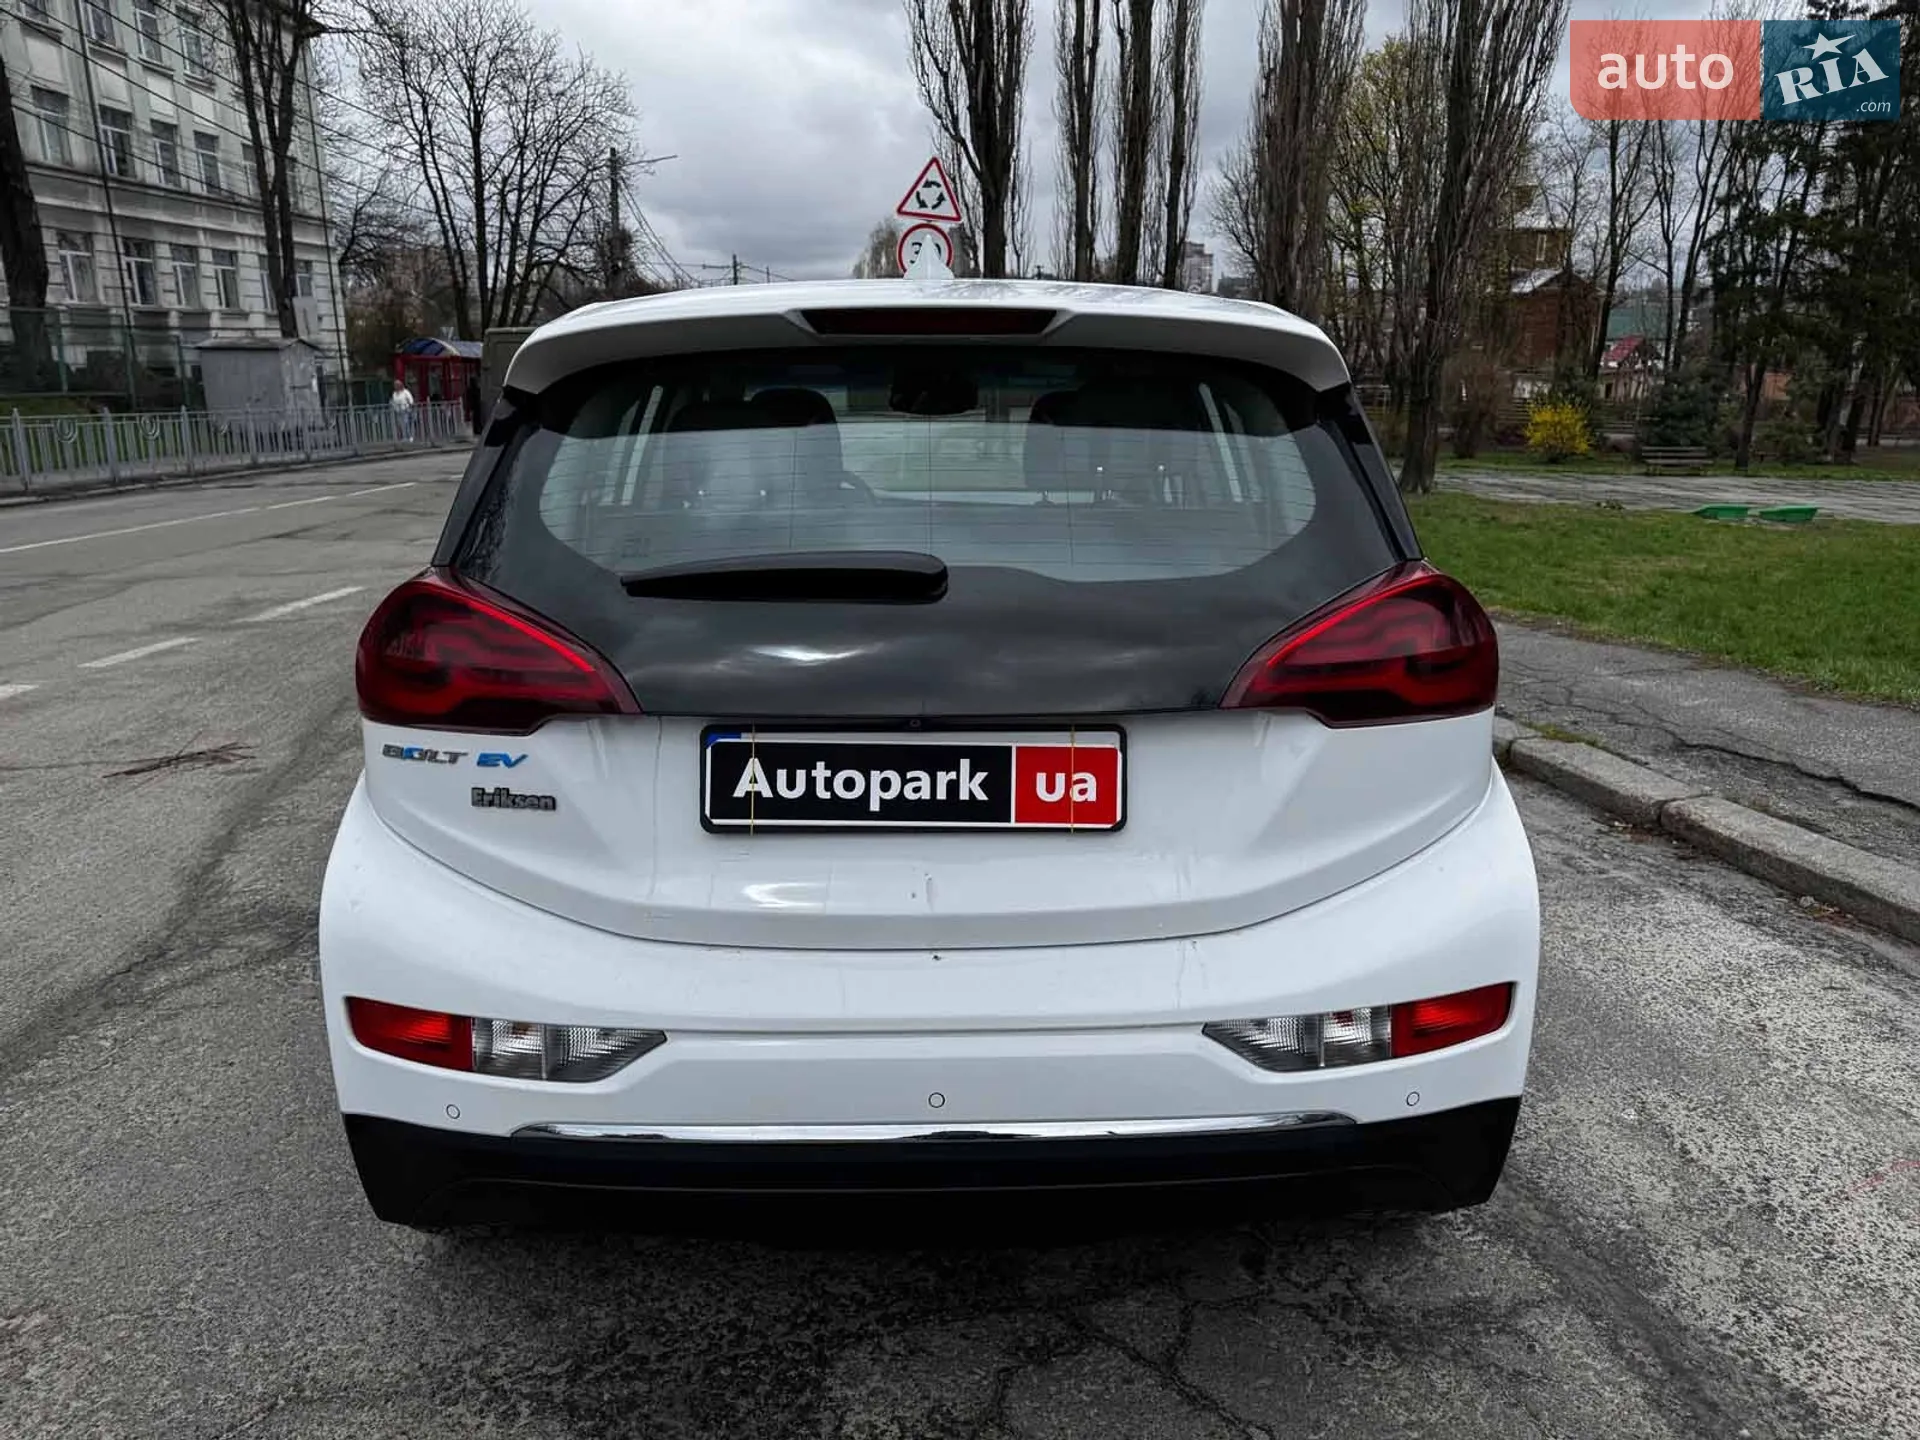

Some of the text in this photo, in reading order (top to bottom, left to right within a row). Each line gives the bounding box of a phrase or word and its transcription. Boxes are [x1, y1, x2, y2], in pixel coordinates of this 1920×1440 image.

[382, 744, 528, 768] BOLT EV
[733, 757, 1097, 812] Autopark ua
[471, 787, 557, 811] Eriksen
